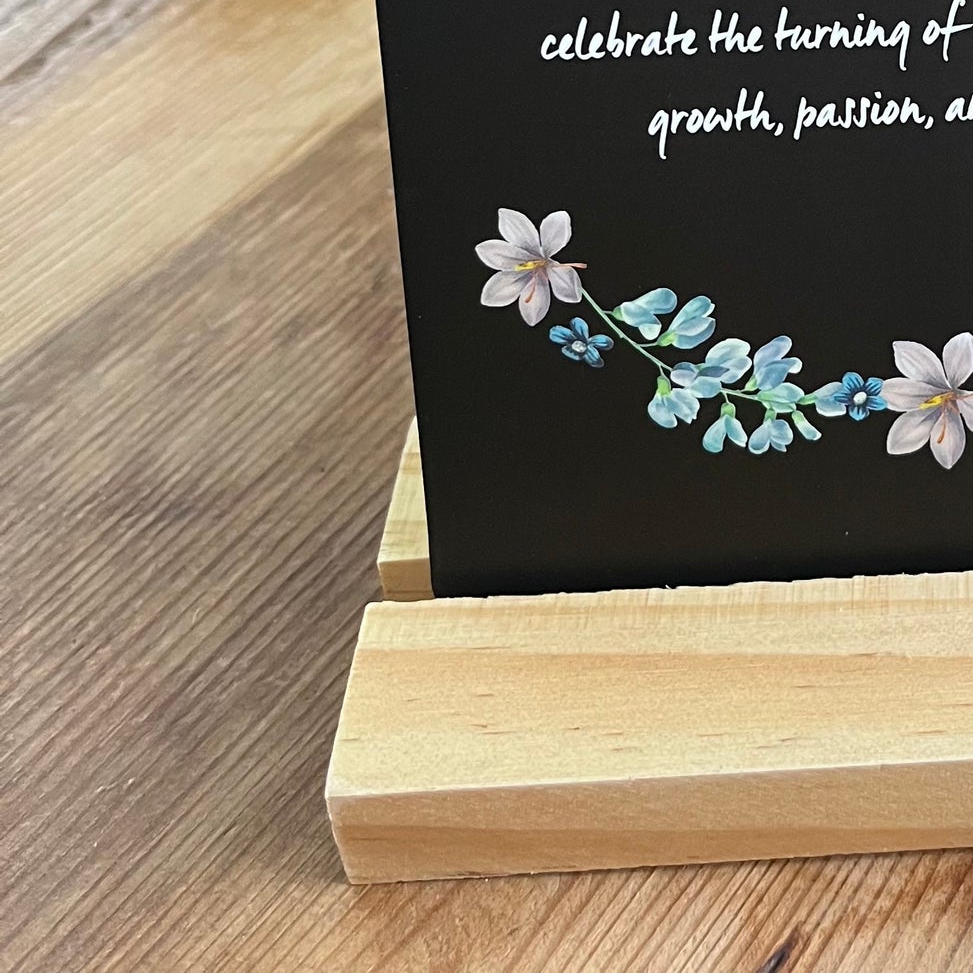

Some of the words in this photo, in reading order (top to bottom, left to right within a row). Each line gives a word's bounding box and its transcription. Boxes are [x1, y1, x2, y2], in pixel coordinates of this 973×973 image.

[540, 11, 697, 61] celebrate
[709, 9, 763, 53] the
[775, 6, 910, 70] turning
[648, 88, 784, 160] growth,
[793, 91, 934, 140] passion,
